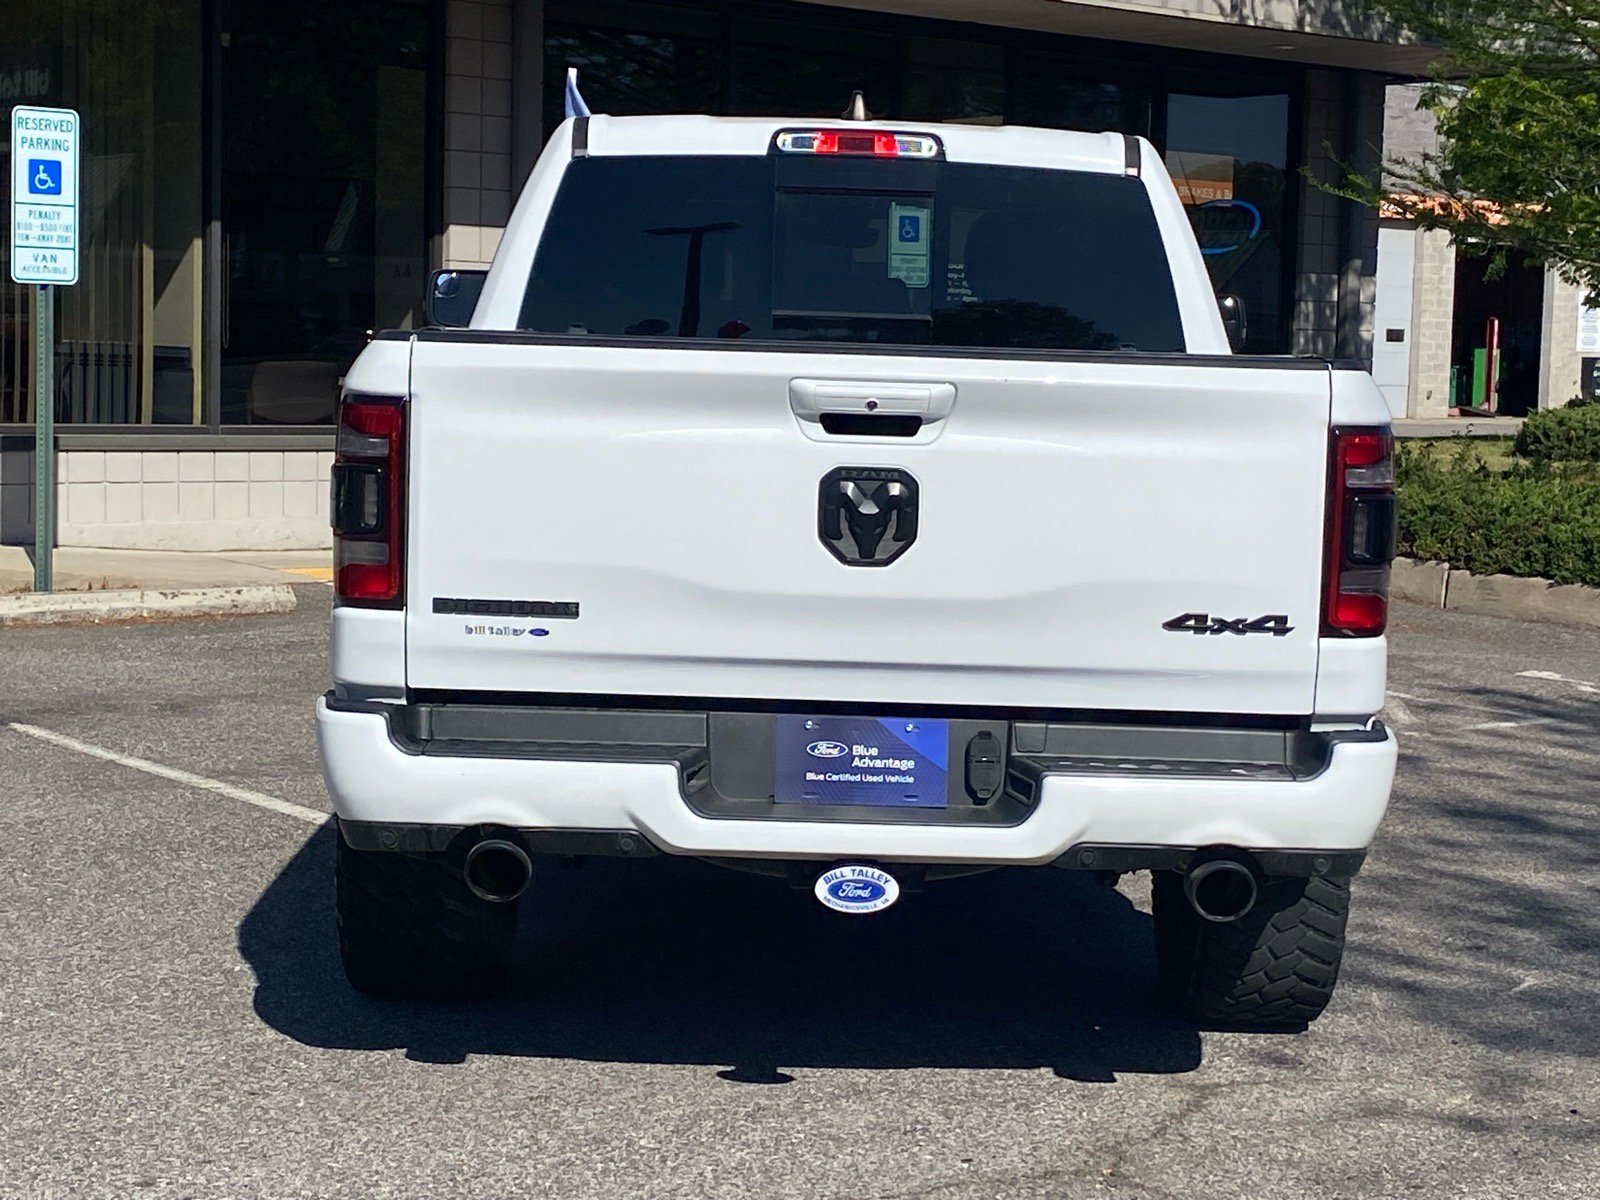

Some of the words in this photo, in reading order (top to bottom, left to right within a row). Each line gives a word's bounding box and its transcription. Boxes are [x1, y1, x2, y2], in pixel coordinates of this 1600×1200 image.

[17, 116, 73, 133] RESERVED
[21, 137, 70, 152] PARKING
[28, 209, 61, 221] PENALTY
[32, 253, 58, 264] VAN
[21, 264, 68, 275] ACCESSIBLE
[840, 470, 899, 480] RAM
[464, 624, 486, 636] bill
[488, 625, 527, 638] talley
[1161, 612, 1297, 637] 4x4
[813, 742, 842, 756] Ford
[852, 744, 879, 756] Blue
[852, 757, 916, 770] Advantage
[805, 771, 824, 782] Blue
[826, 772, 861, 782] Certified
[862, 773, 884, 783] Used
[885, 774, 915, 784] Vehicle
[823, 868, 847, 885] BILL
[850, 868, 892, 885] TALLEY
[838, 881, 872, 898] Ford
